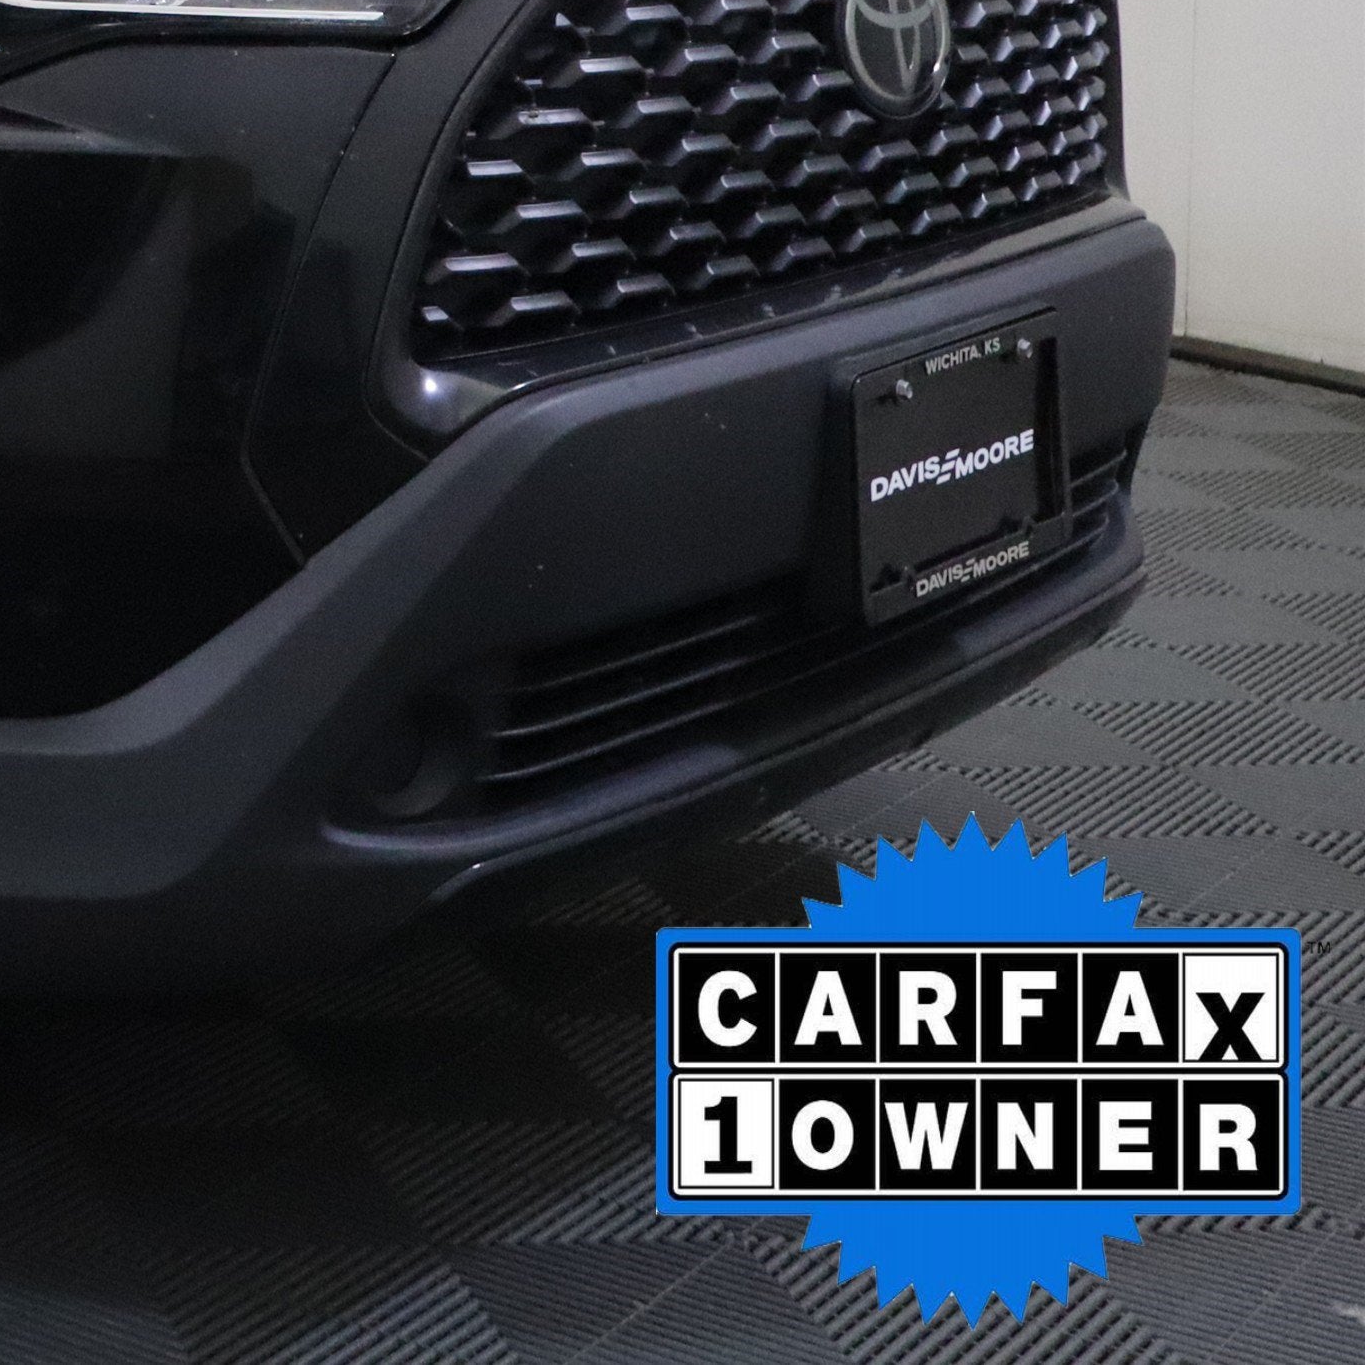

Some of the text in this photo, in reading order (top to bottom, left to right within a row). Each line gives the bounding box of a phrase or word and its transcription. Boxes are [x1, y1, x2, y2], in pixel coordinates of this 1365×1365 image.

[984, 337, 1001, 355] KS
[870, 429, 1034, 502] DAVIS MOORE
[916, 540, 1029, 597] DAVIS MOORE
